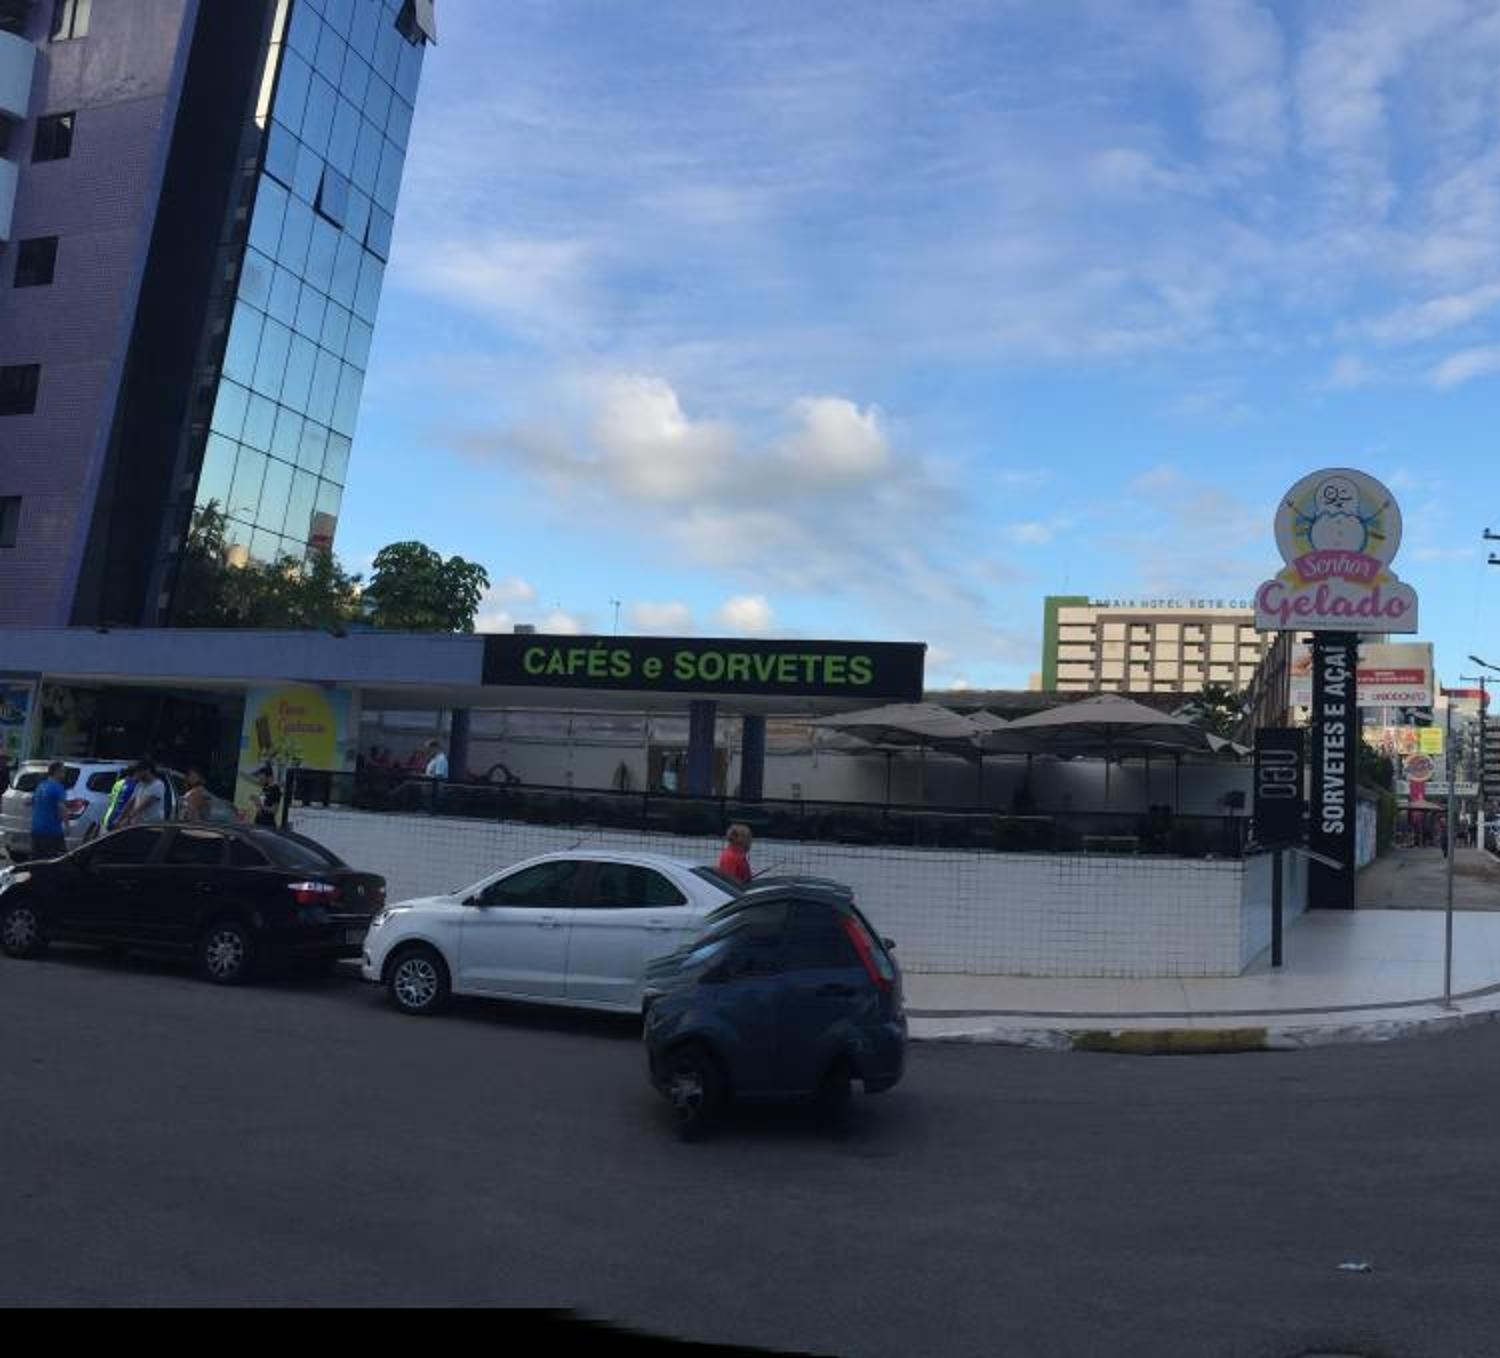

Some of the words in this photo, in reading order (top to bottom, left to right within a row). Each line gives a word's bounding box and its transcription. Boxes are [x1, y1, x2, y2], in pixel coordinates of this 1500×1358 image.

[1304, 554, 1372, 578] Senhor
[1141, 599, 1184, 609] HOTEL
[1259, 581, 1412, 625] Gelado
[523, 642, 632, 677] CAFÉS
[643, 658, 663, 679] e
[673, 649, 875, 686] SORVETES
[1320, 643, 1353, 698] AÇAÍ
[1324, 703, 1346, 716] E
[1322, 721, 1347, 835] SORVETES
